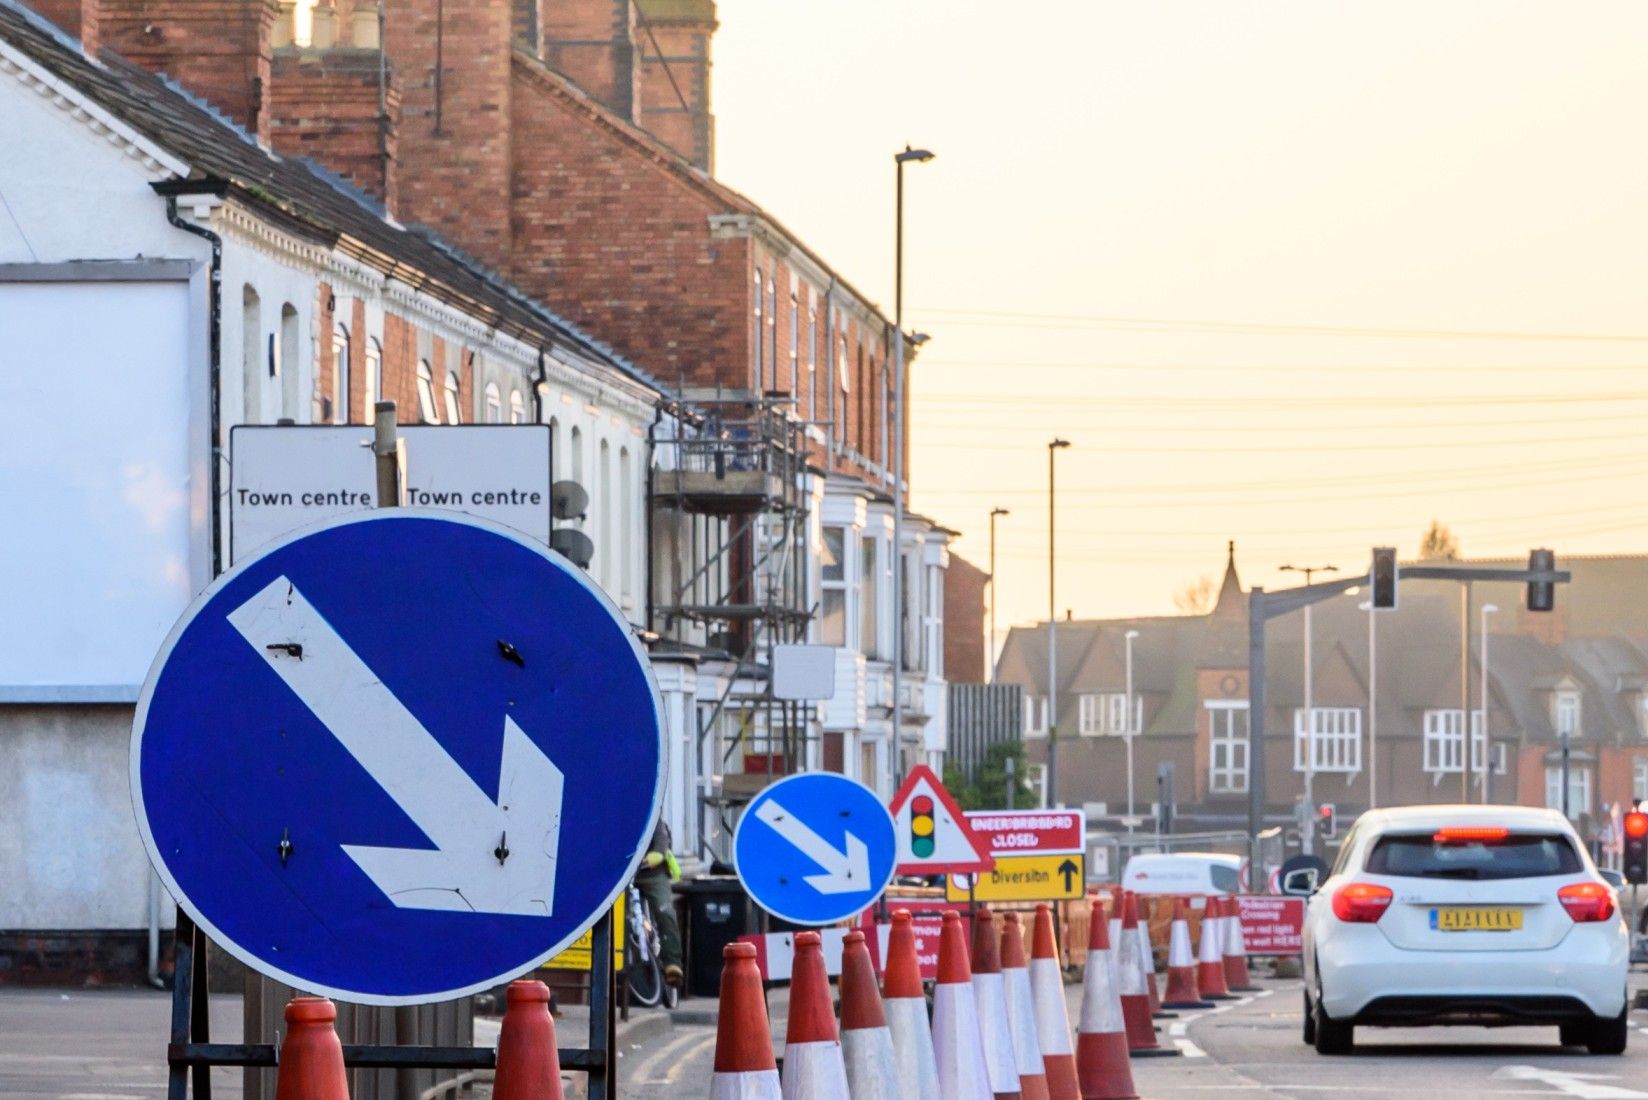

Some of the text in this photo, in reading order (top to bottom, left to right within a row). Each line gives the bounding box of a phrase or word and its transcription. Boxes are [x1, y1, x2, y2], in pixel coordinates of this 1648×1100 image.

[236, 488, 372, 506] Town centre
[406, 487, 541, 505] Town centre
[992, 833, 1039, 847] CLOSED
[992, 870, 1049, 884] Diversion
